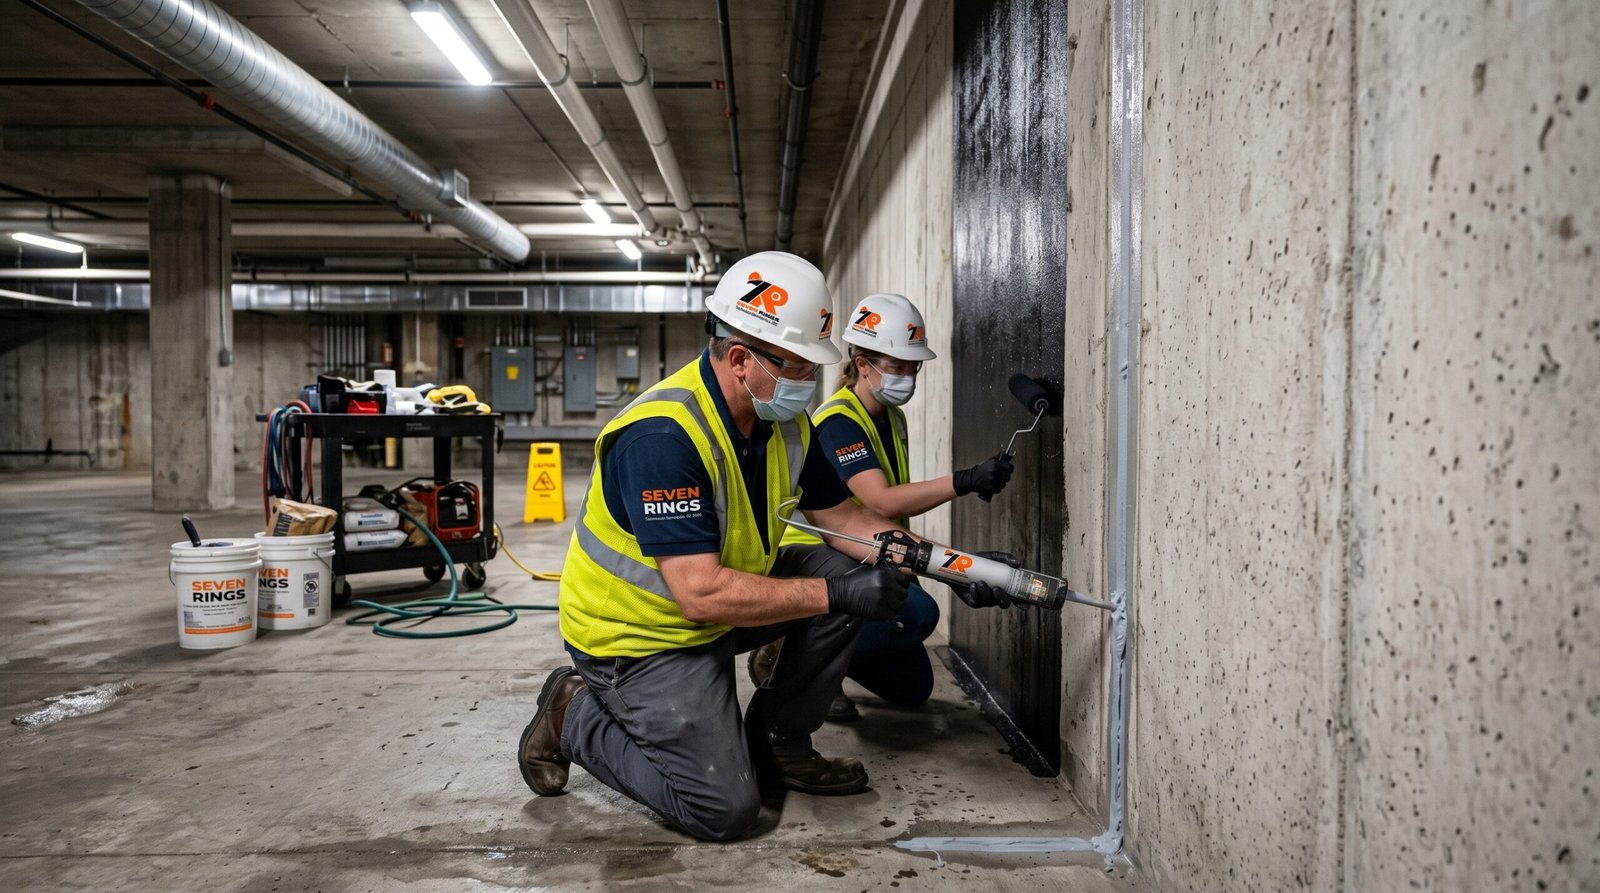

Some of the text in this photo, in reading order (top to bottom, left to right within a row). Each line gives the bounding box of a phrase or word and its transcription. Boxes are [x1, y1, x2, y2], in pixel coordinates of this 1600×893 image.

[835, 441, 866, 456] SEVEN
[838, 448, 868, 463] RINGS
[642, 486, 700, 502] SEVEN
[643, 499, 701, 515] RINGS
[258, 568, 289, 577] VEN
[191, 578, 247, 591] SEVEN
[258, 578, 289, 588] NGS
[193, 589, 246, 603] RINGS
